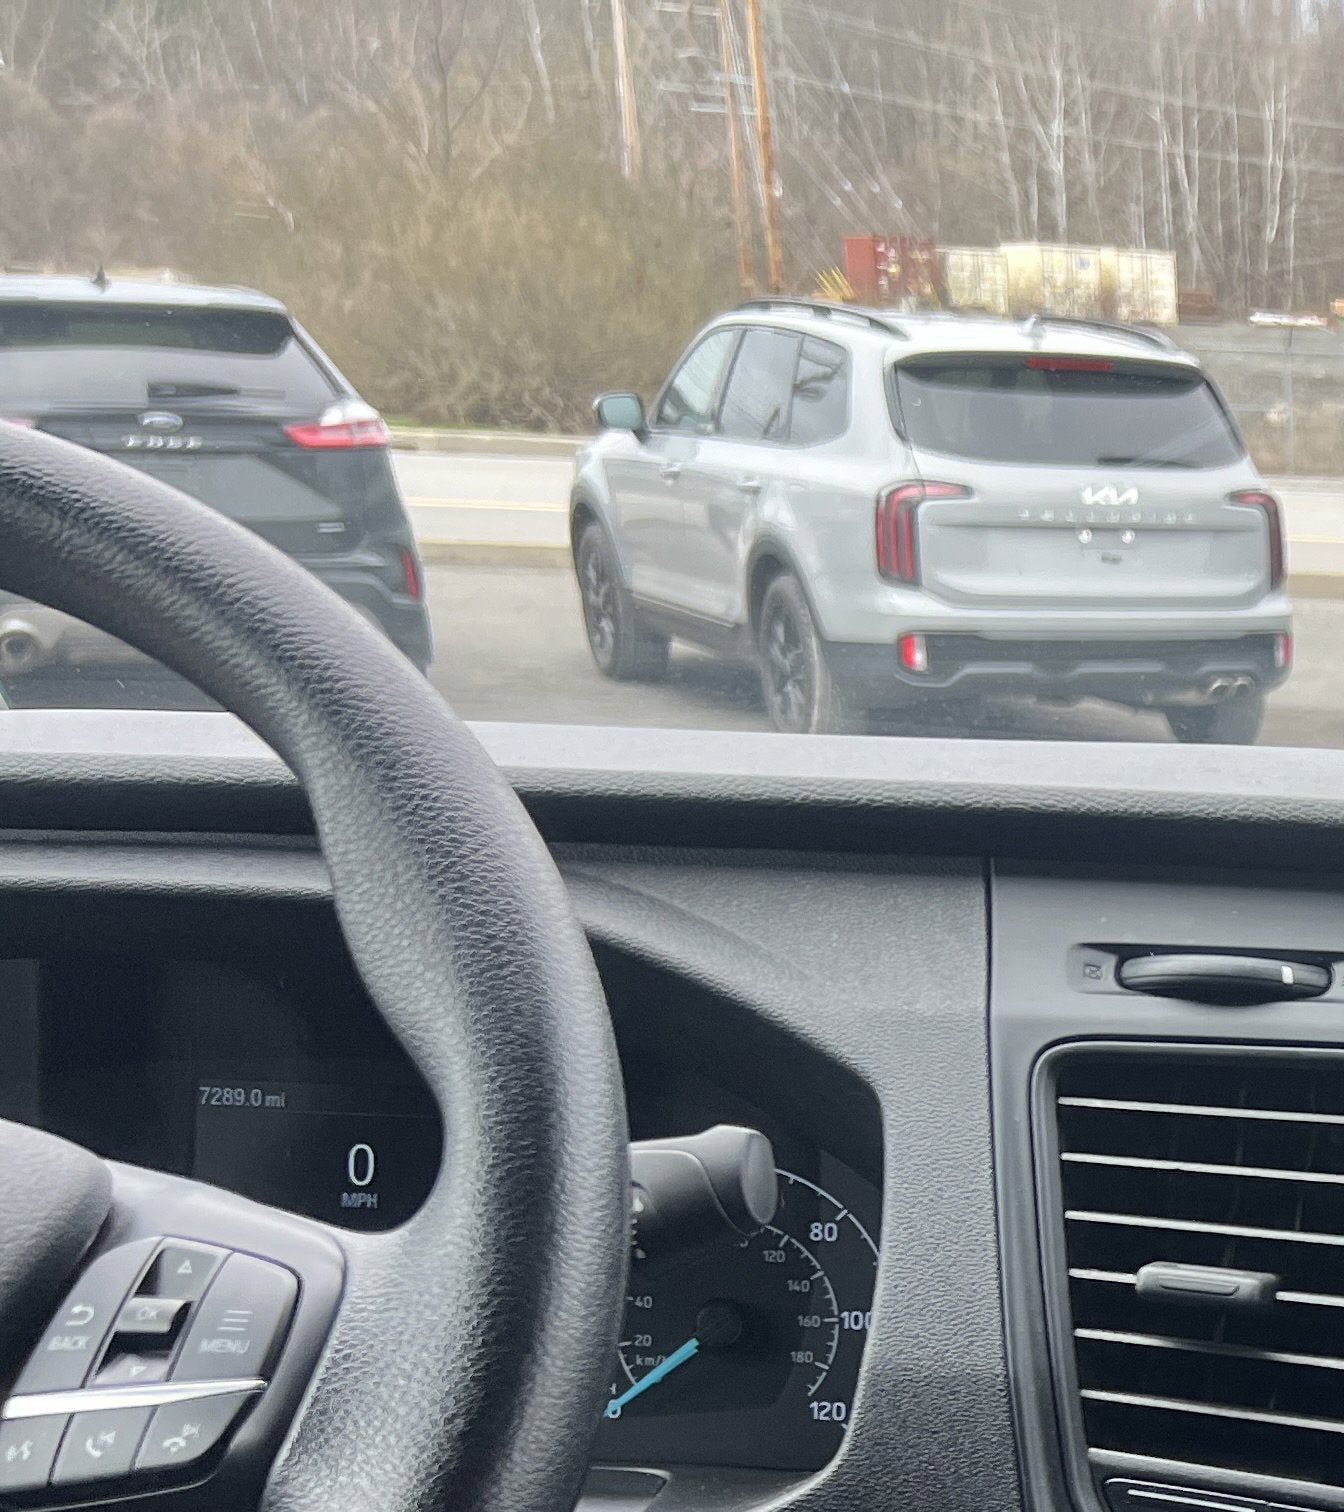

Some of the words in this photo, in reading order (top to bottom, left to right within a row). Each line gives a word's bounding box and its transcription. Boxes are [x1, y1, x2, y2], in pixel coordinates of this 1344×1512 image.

[199, 1086, 262, 1107] 7289.0
[348, 1143, 376, 1186] 0
[341, 1192, 378, 1209] MPH
[809, 1222, 838, 1242] 80
[762, 1250, 786, 1263] 120
[787, 1279, 810, 1293] 140
[634, 1295, 653, 1309] 40
[797, 1315, 821, 1328] 160
[634, 1334, 652, 1347] 20
[790, 1351, 814, 1364] 180
[809, 1401, 847, 1422] 120
